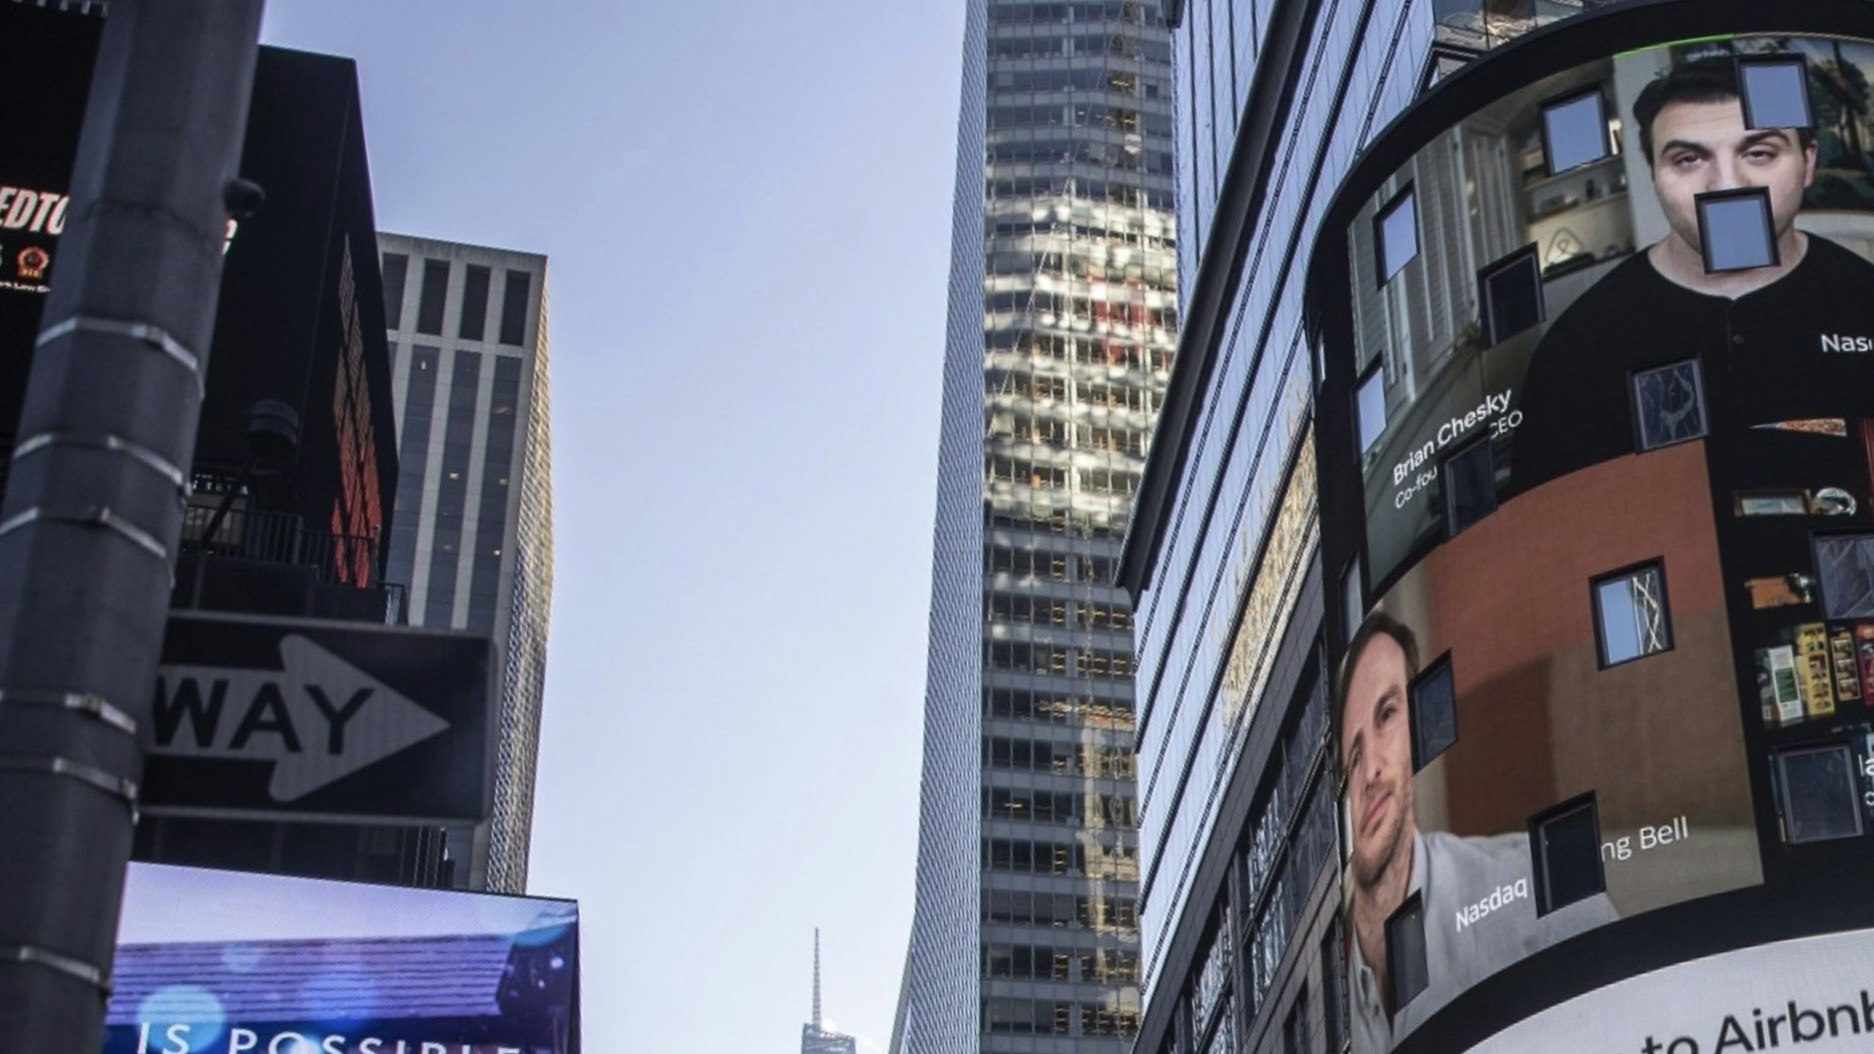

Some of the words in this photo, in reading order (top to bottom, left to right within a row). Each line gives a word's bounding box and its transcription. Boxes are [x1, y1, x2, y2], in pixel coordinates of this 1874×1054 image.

[1821, 334, 1872, 353] Nas
[1393, 440, 1435, 486] Brian
[1437, 389, 1512, 447] Chesky
[152, 675, 376, 755] WAY
[1455, 876, 1530, 933] Nasdaq
[1639, 815, 1690, 851] Bell
